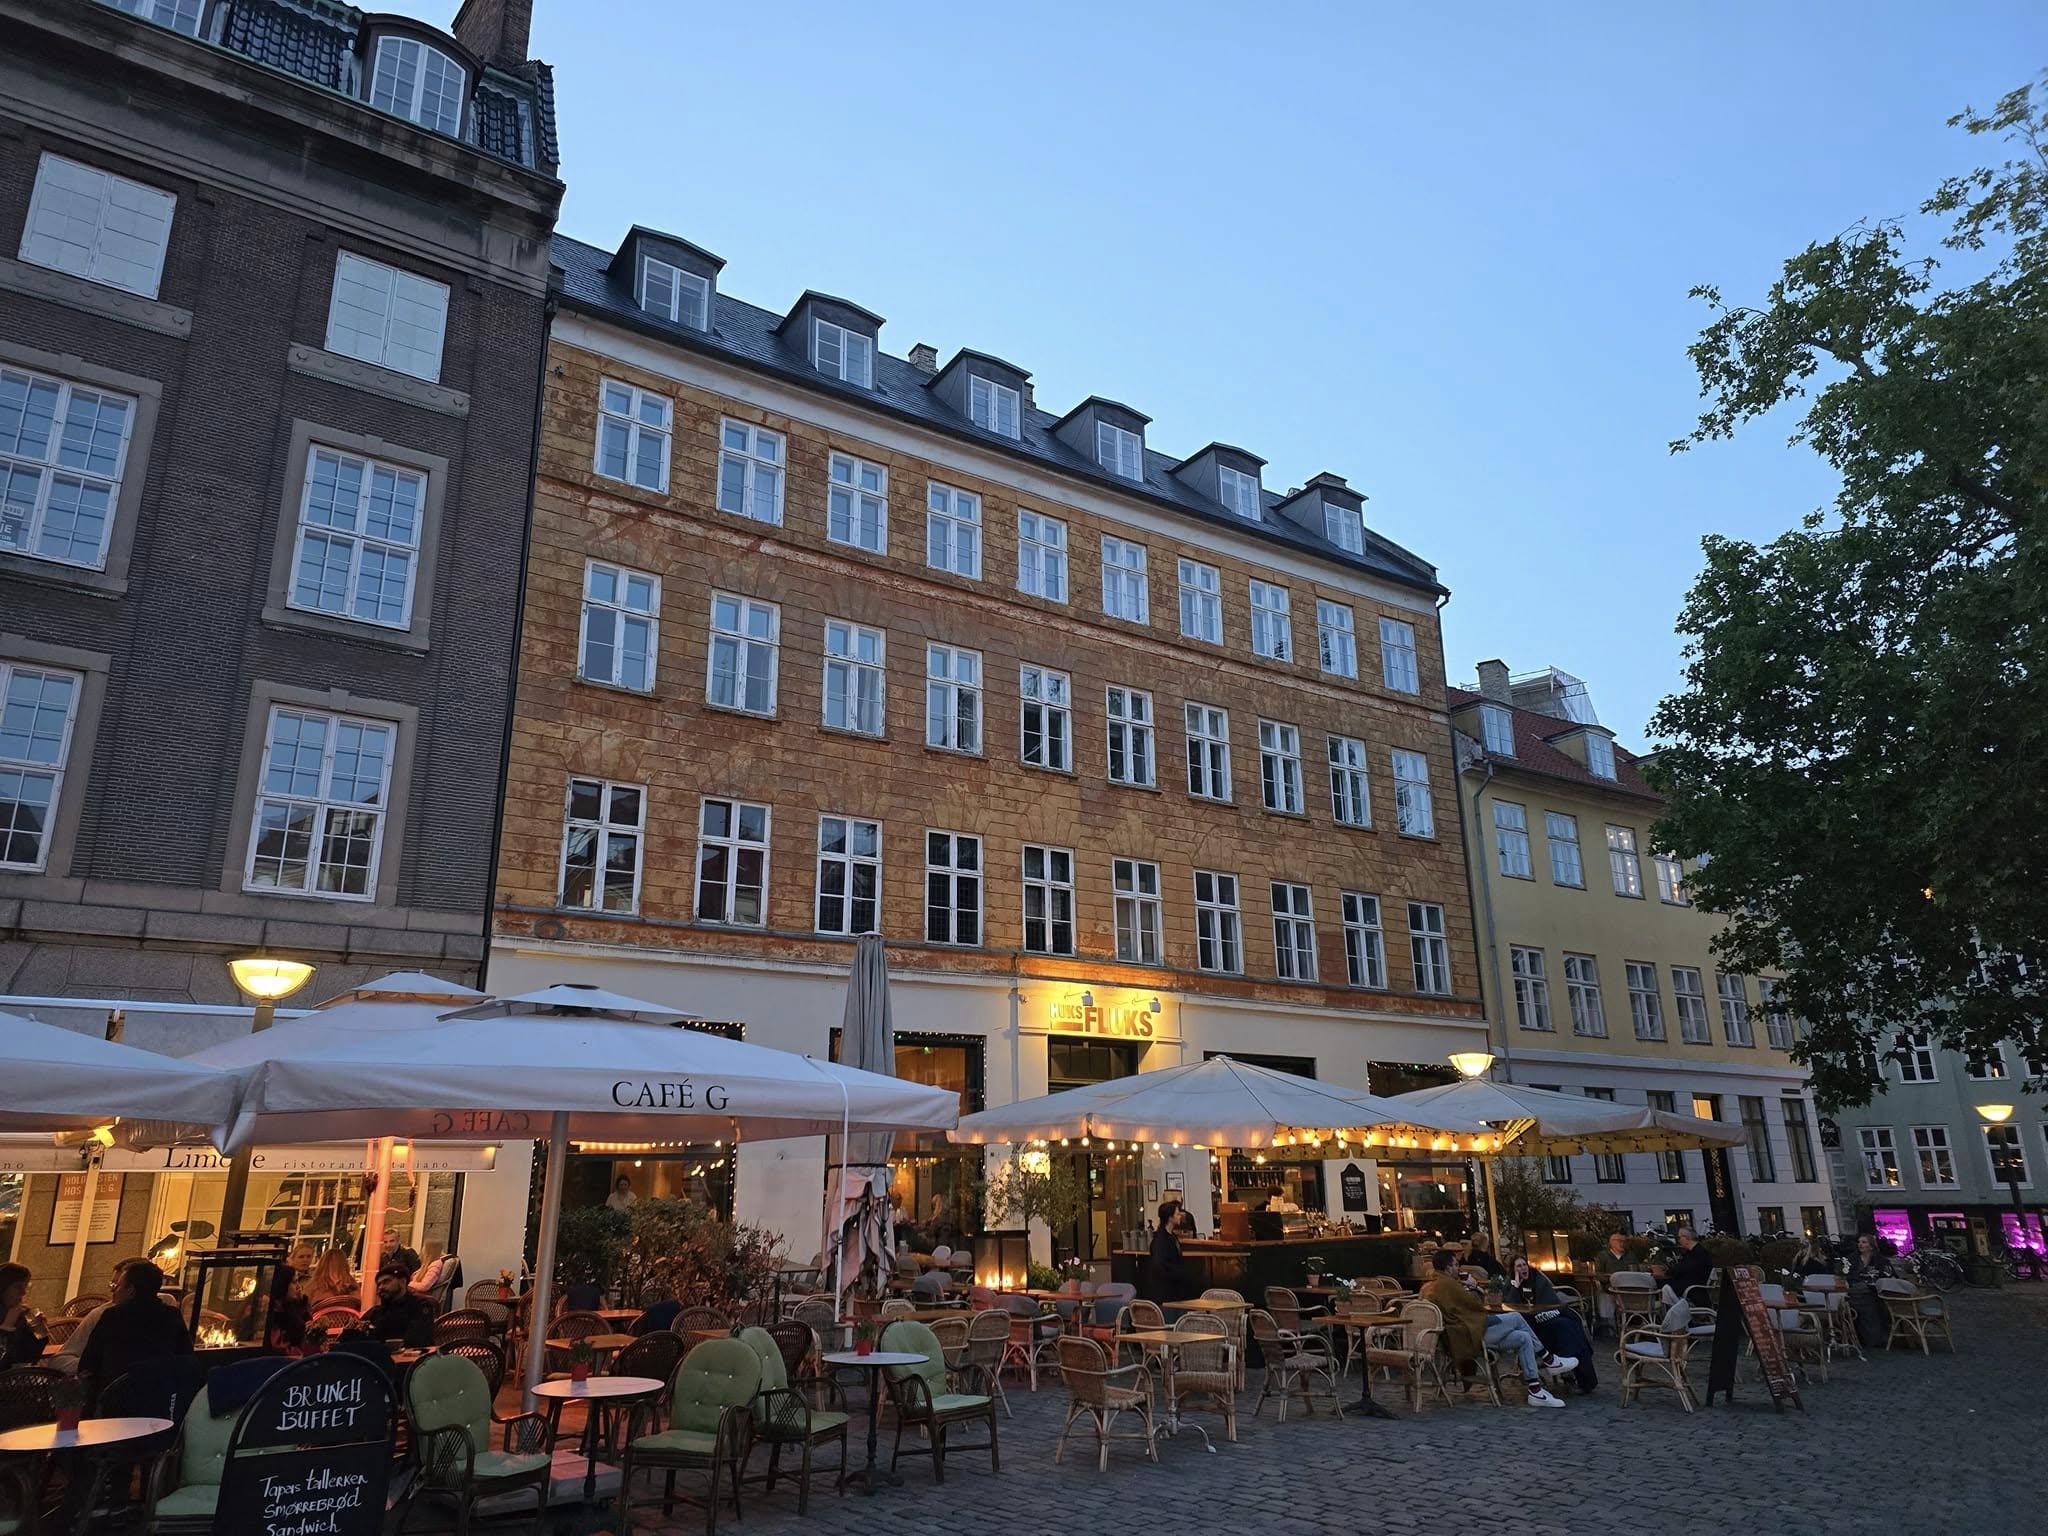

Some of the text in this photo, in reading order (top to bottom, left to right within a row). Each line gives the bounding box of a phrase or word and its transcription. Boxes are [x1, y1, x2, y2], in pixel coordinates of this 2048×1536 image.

[1050, 1003, 1153, 1036] HUKS FLUKS
[612, 1078, 730, 1110] CAFÉ G
[163, 1147, 266, 1169] Limoe
[63, 1186, 82, 1197] HOS
[282, 1378, 362, 1408] BRUNCH
[275, 1402, 367, 1431] BUFFET
[259, 1475, 301, 1503] Tapas
[266, 1512, 342, 1536] Sandwich
